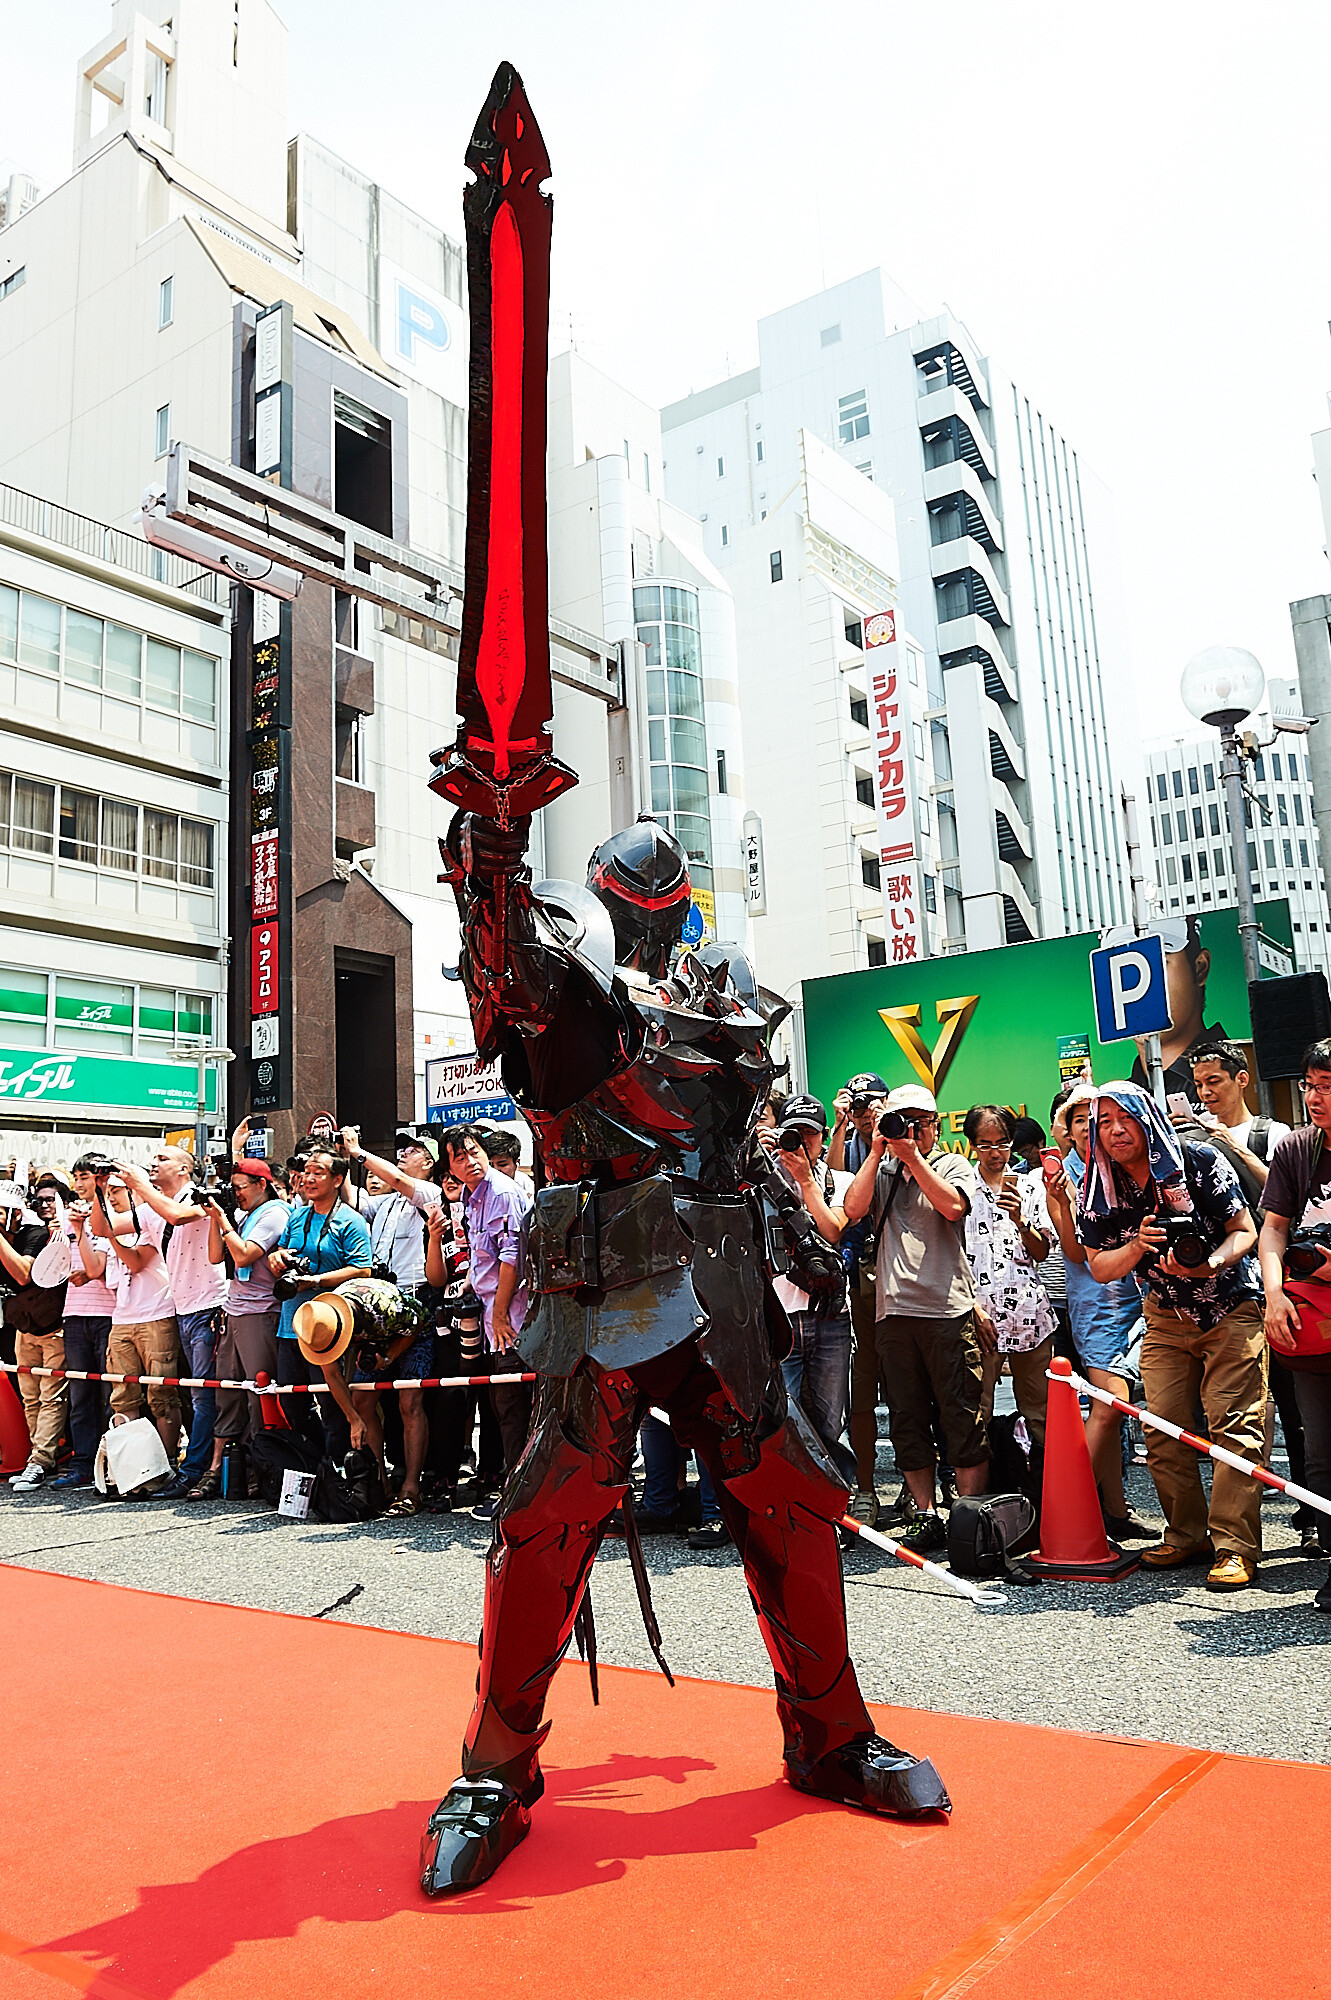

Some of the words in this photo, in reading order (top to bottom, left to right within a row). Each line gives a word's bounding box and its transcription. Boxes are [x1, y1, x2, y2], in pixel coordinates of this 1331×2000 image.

[396, 280, 450, 363] P
[872, 668, 906, 820] ジャンカラ
[259, 807, 272, 820] 3F
[265, 842, 278, 878] 名古屋
[747, 835, 761, 900] 大野屋ビル
[887, 874, 917, 961] 歌い放
[259, 948, 271, 997] アコム
[1109, 951, 1151, 1031] P
[76, 1005, 113, 1021] エイブル
[261, 1001, 269, 1009] 1F
[878, 994, 980, 1100] V
[1061, 1067, 1080, 1076] EX
